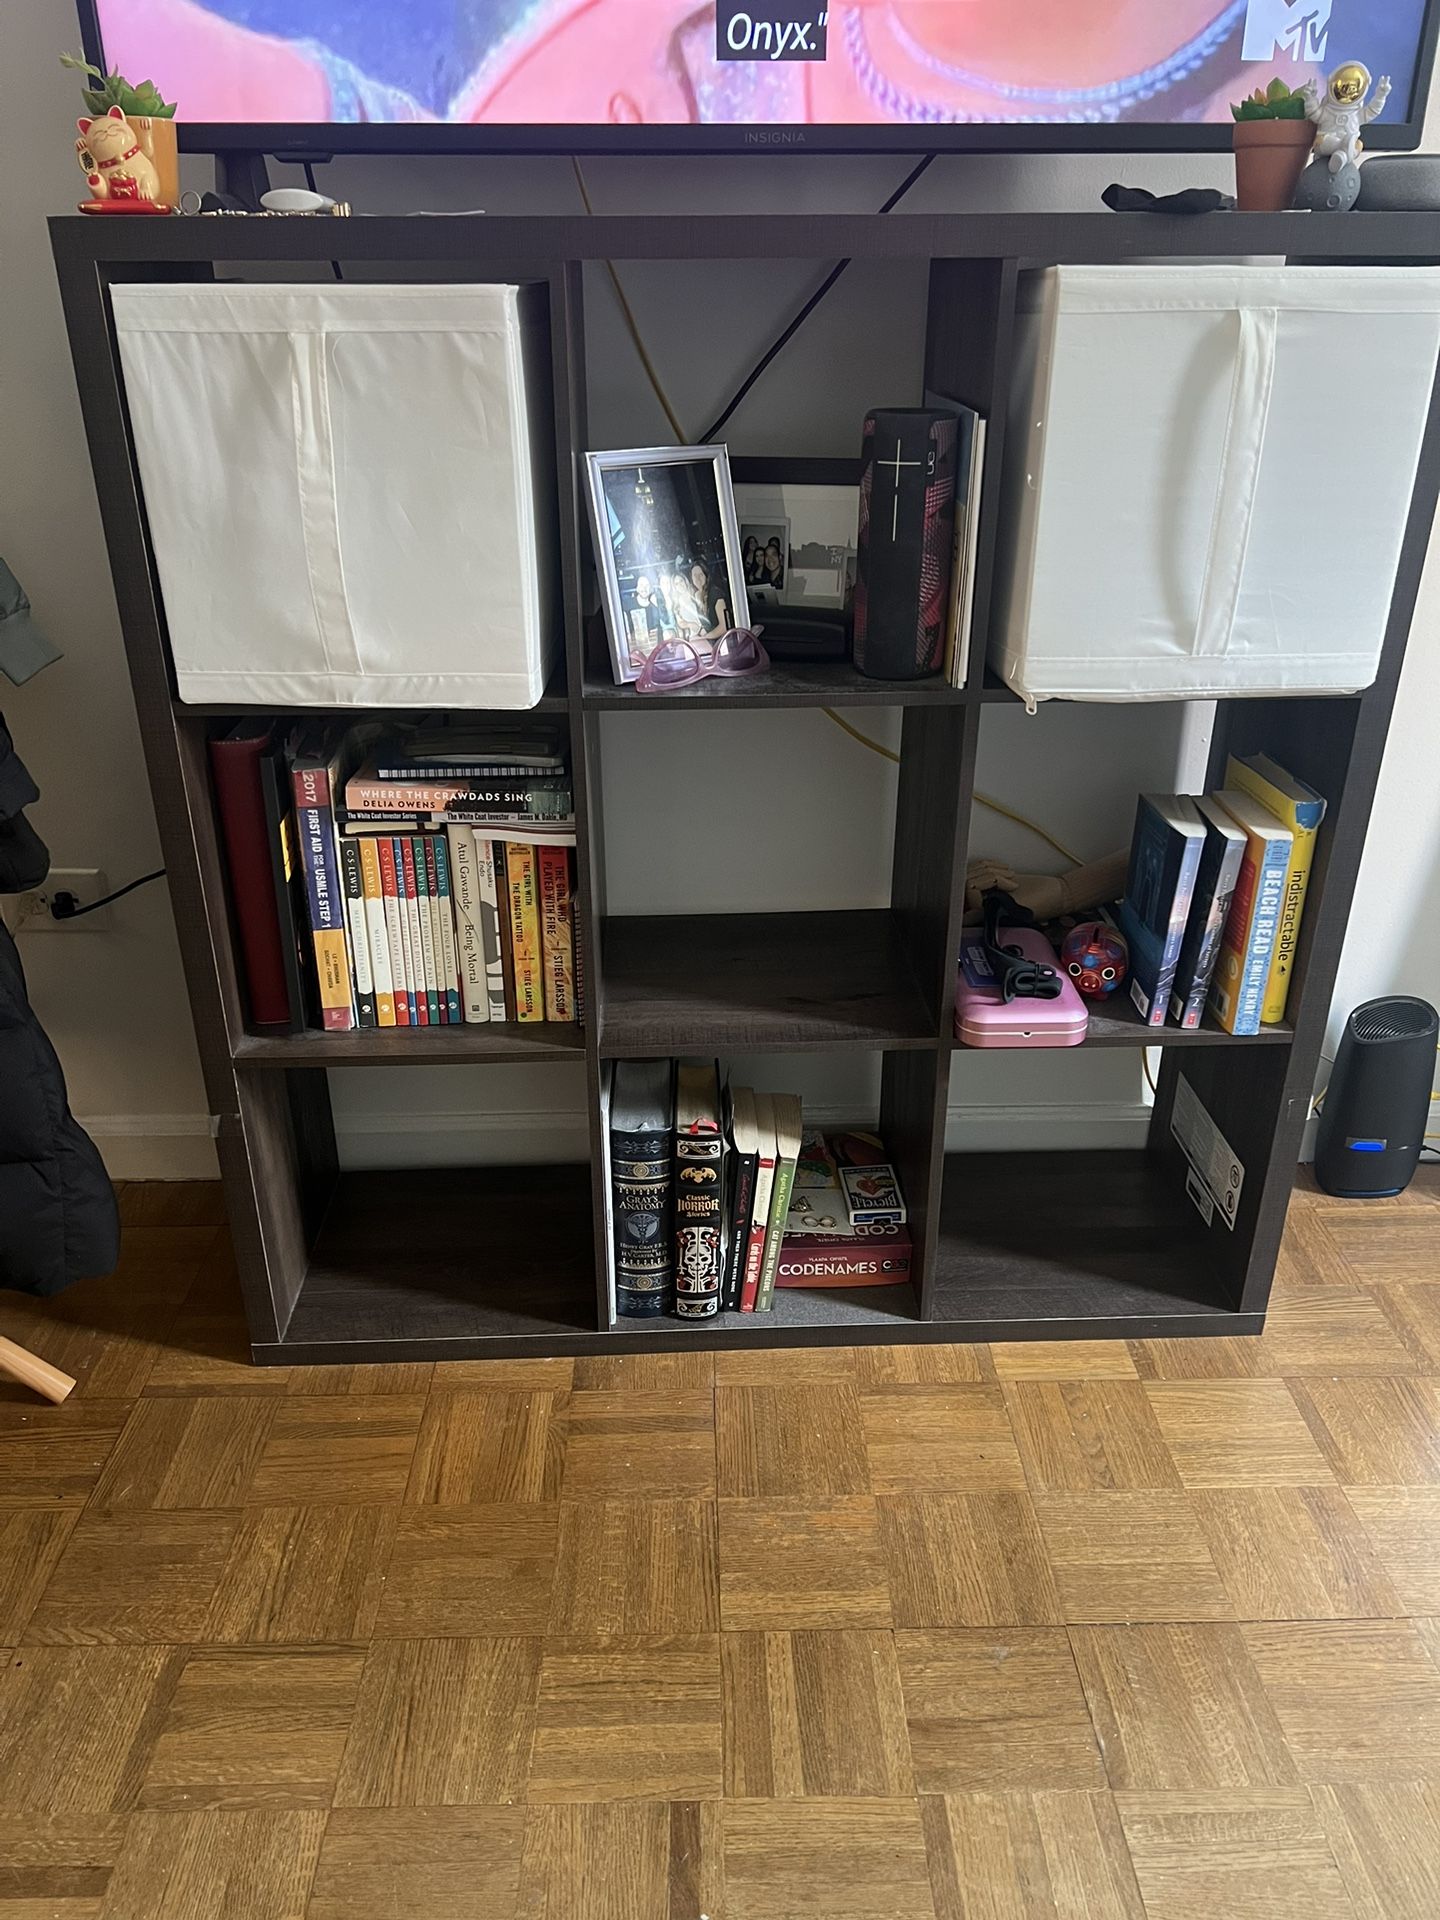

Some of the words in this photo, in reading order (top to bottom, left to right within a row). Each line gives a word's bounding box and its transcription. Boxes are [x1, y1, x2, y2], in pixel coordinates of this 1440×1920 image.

[727, 12, 828, 60] Onyx."
[1241, 0, 1332, 62] MTV
[744, 132, 805, 143] INSIGNIA
[302, 771, 317, 803] 2017
[360, 790, 402, 799] WHERE
[406, 791, 428, 800] THE
[433, 791, 500, 801] CRAWDADS
[504, 792, 533, 802] SING
[363, 800, 394, 808] DELIA
[398, 801, 436, 809] OWENS
[307, 809, 320, 835] FIRST
[447, 812, 457, 820] The
[458, 812, 474, 820] White
[310, 837, 322, 853] AID
[457, 842, 469, 863] Atul
[315, 868, 328, 898] USMLE
[348, 866, 358, 893] LEWIS
[366, 866, 376, 893] LEWIS
[384, 865, 394, 892] LEWIS
[396, 866, 405, 893] LEWIS
[406, 865, 416, 892] LEWIS
[416, 864, 426, 891] LEWIS
[427, 864, 436, 892] LEWIS
[437, 863, 448, 890] LEWIS
[486, 861, 494, 888] Shusaku
[544, 862, 555, 893] PLAYED
[555, 866, 564, 882] THE
[460, 863, 472, 910] Gawande
[512, 882, 520, 894] THE
[556, 883, 566, 901] GIRL
[1258, 870, 1283, 915] BEACH
[513, 895, 522, 919] DRAGON
[524, 890, 532, 906] WITH
[545, 894, 555, 914] WITH
[318, 900, 331, 924] STEP
[557, 902, 567, 922] WHO
[1278, 870, 1306, 960] indistractable
[515, 920, 523, 943] TATTOO
[546, 915, 556, 935] FIRE
[463, 924, 474, 951] Being
[1252, 920, 1274, 955] READ
[414, 950, 422, 982] DIVORCE
[426, 958, 431, 966] OF
[445, 952, 453, 973] LOVES
[467, 952, 479, 984] Mortal
[554, 955, 564, 977] STIEG
[524, 970, 532, 986] STIEG
[1249, 960, 1264, 988] EMILY
[524, 987, 533, 1013] LARSSON
[1159, 994, 1164, 1004] 1
[1192, 997, 1200, 1007] 2
[1244, 988, 1260, 1016] HENRY
[779, 1173, 788, 1194] Agatha
[619, 1200, 667, 1211] ANATOMY
[626, 1195, 659, 1203] GRAY'S
[677, 1198, 720, 1212] HORROR
[776, 1194, 785, 1218] Christie
[851, 1193, 898, 1209] BICYCLE
[772, 1230, 780, 1240] CAT
[749, 1243, 762, 1256] Cards
[769, 1240, 778, 1259] AMONG
[766, 1259, 775, 1270] THE
[778, 1261, 877, 1276] CODENAMES
[746, 1270, 758, 1283] Table
[762, 1269, 773, 1292] PIGEONS
